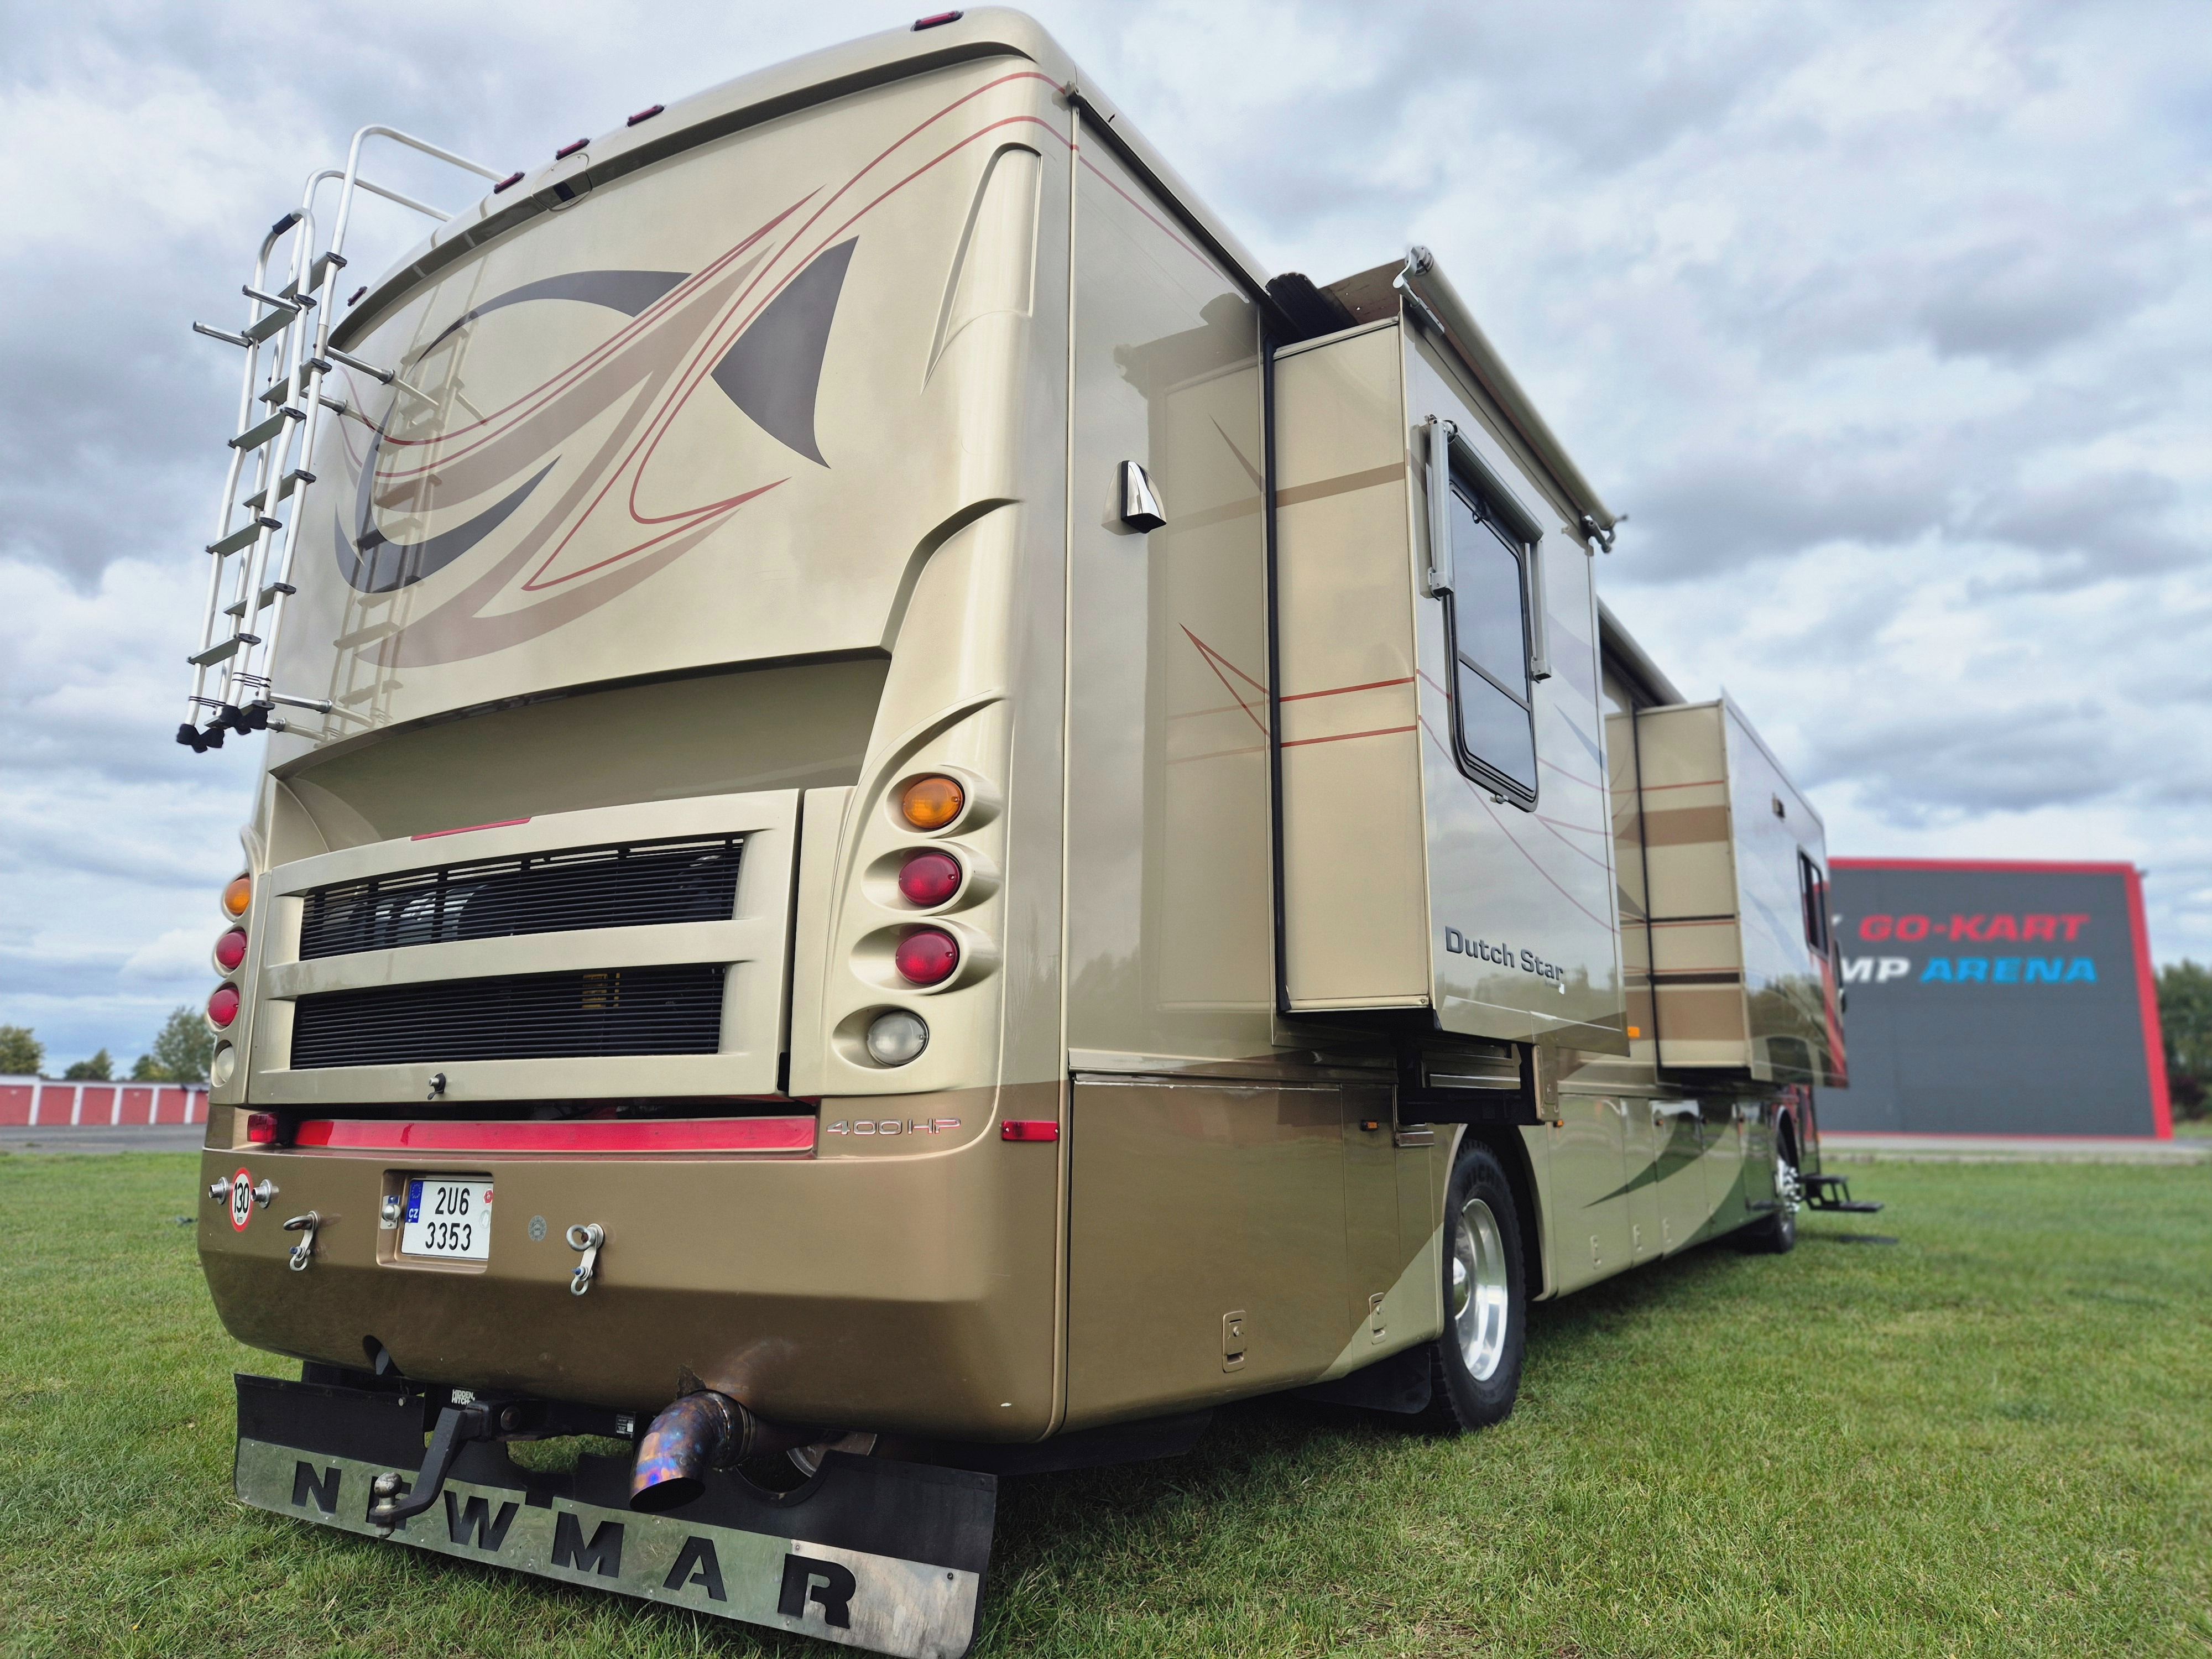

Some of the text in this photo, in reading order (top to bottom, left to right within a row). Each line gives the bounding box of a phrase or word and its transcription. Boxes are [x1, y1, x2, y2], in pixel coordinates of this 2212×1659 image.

[1859, 914, 2091, 941] GO-KART
[1445, 926, 1564, 980] Dutch Star
[1921, 957, 2097, 984] ARENA
[234, 1182, 250, 1213] 130
[435, 1187, 470, 1215] 2U6
[409, 1208, 419, 1218] CZ
[425, 1222, 472, 1251] 3353
